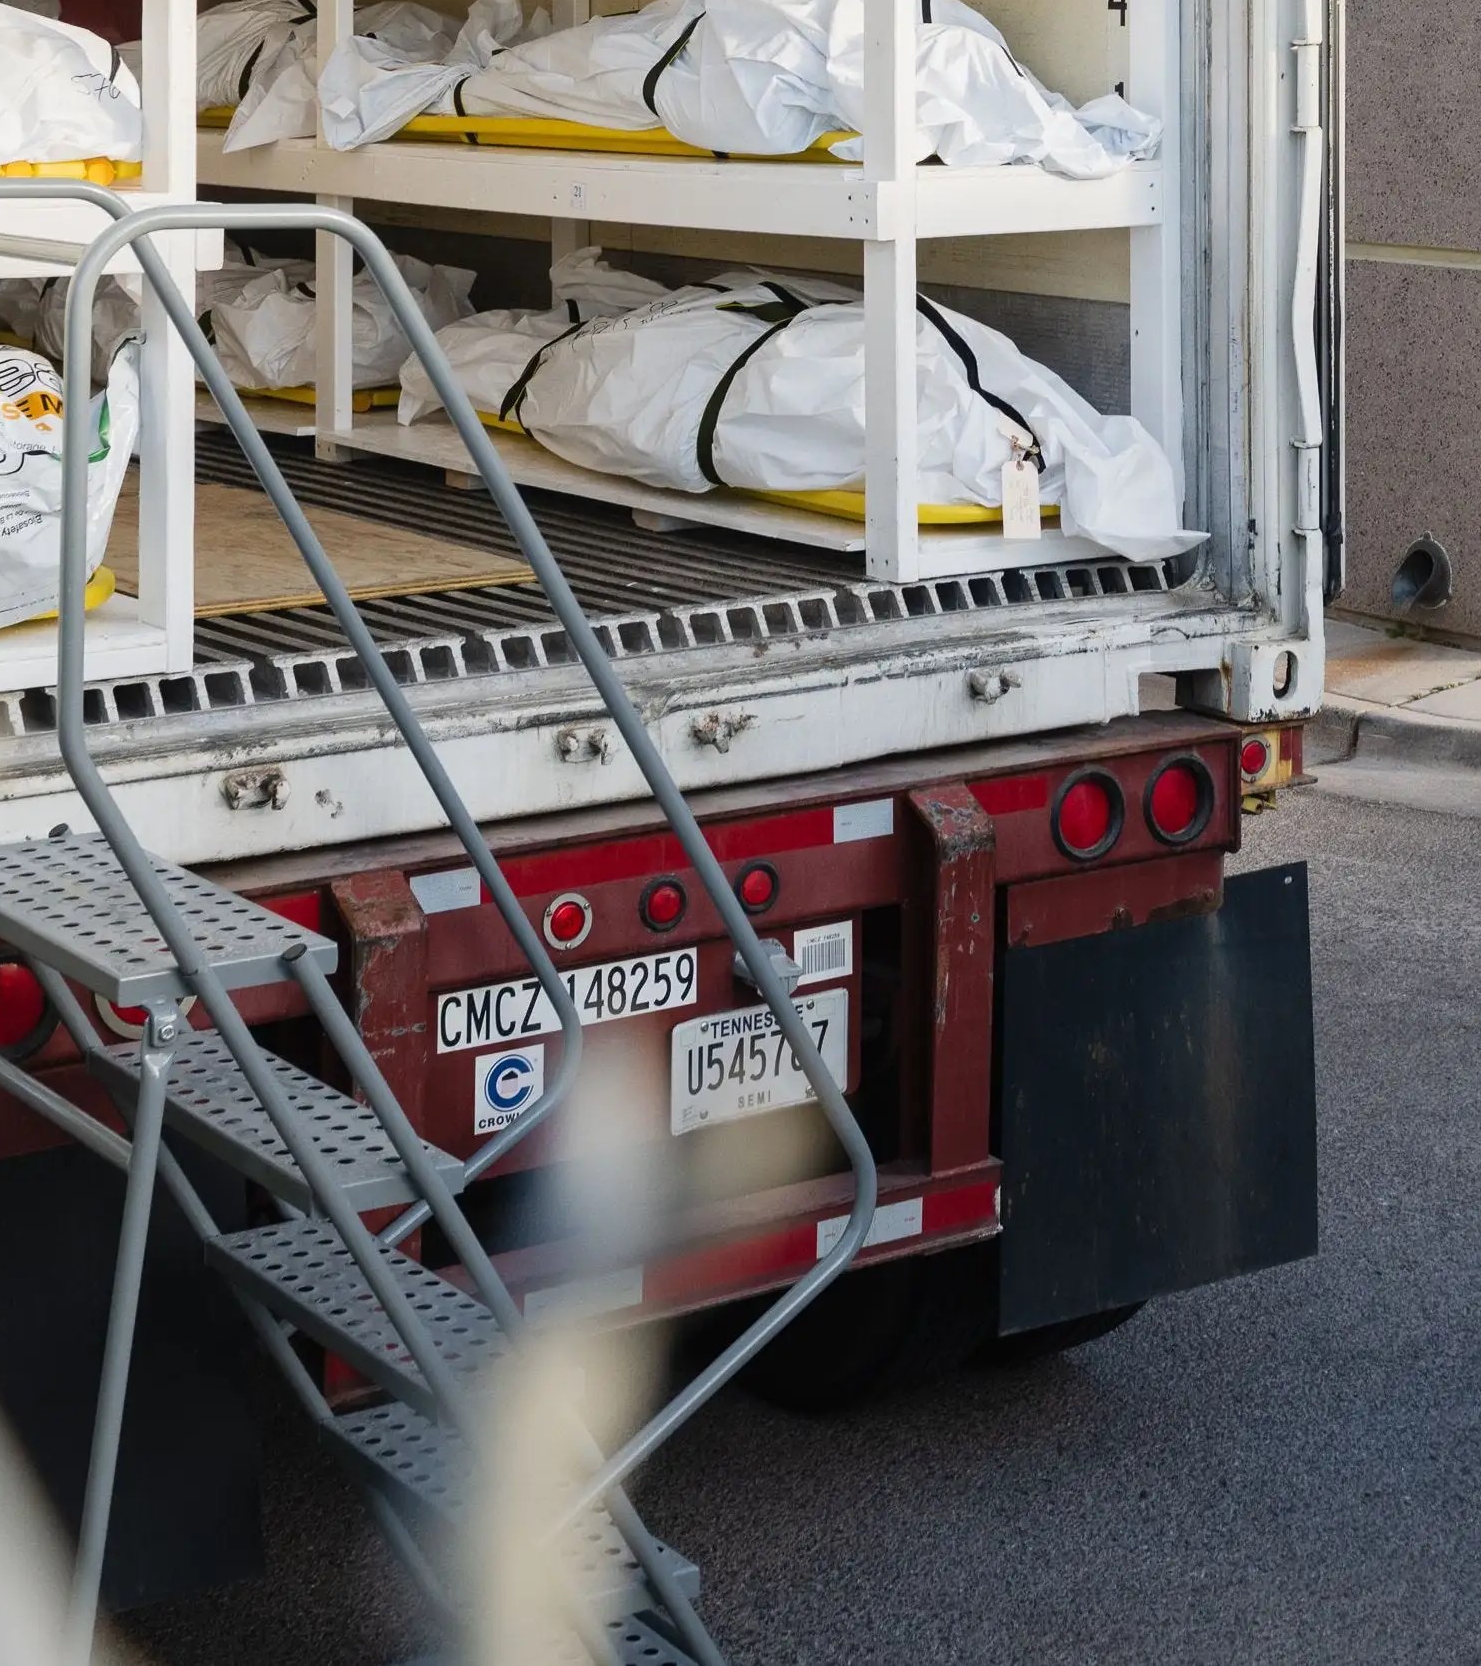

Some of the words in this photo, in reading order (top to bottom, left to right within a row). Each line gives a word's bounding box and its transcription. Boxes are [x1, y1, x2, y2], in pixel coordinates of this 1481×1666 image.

[439, 982, 542, 1047] CMCZ
[566, 952, 694, 1021] 148259
[710, 1003, 804, 1039] TENNESE
[737, 1089, 771, 1110] SEMI
[478, 1112, 520, 1130] CROW
